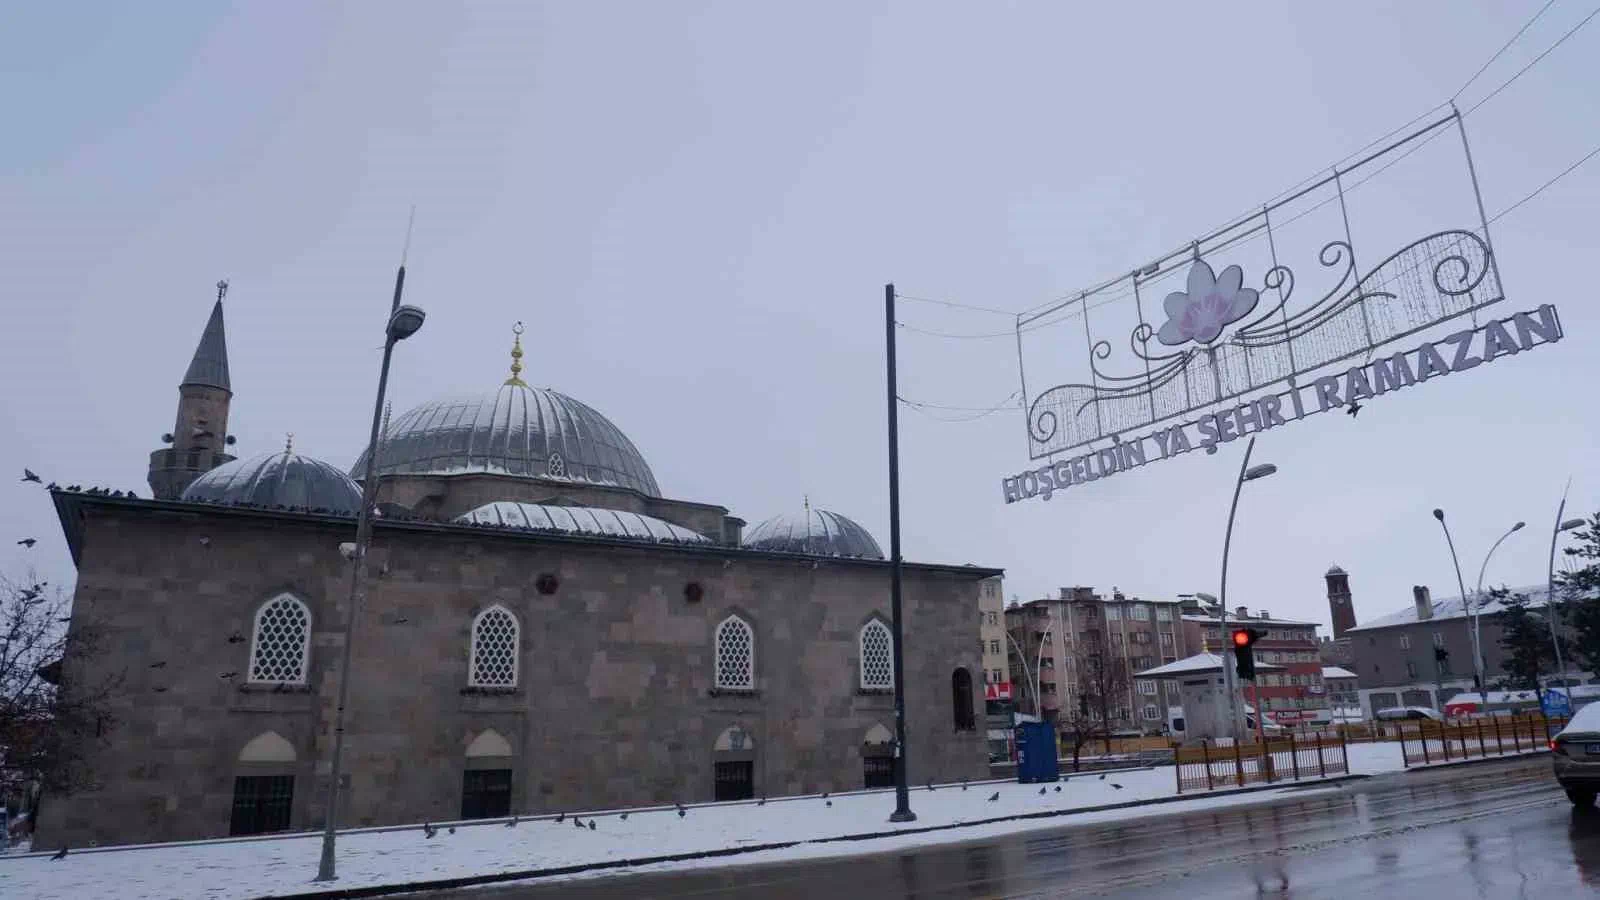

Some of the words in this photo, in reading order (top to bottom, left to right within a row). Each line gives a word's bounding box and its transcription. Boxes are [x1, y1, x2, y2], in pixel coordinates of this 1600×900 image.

[1002, 434, 1146, 504] HOŞGELDİN
[1152, 424, 1192, 460] YA
[1313, 304, 1560, 413] RAMAZAN
